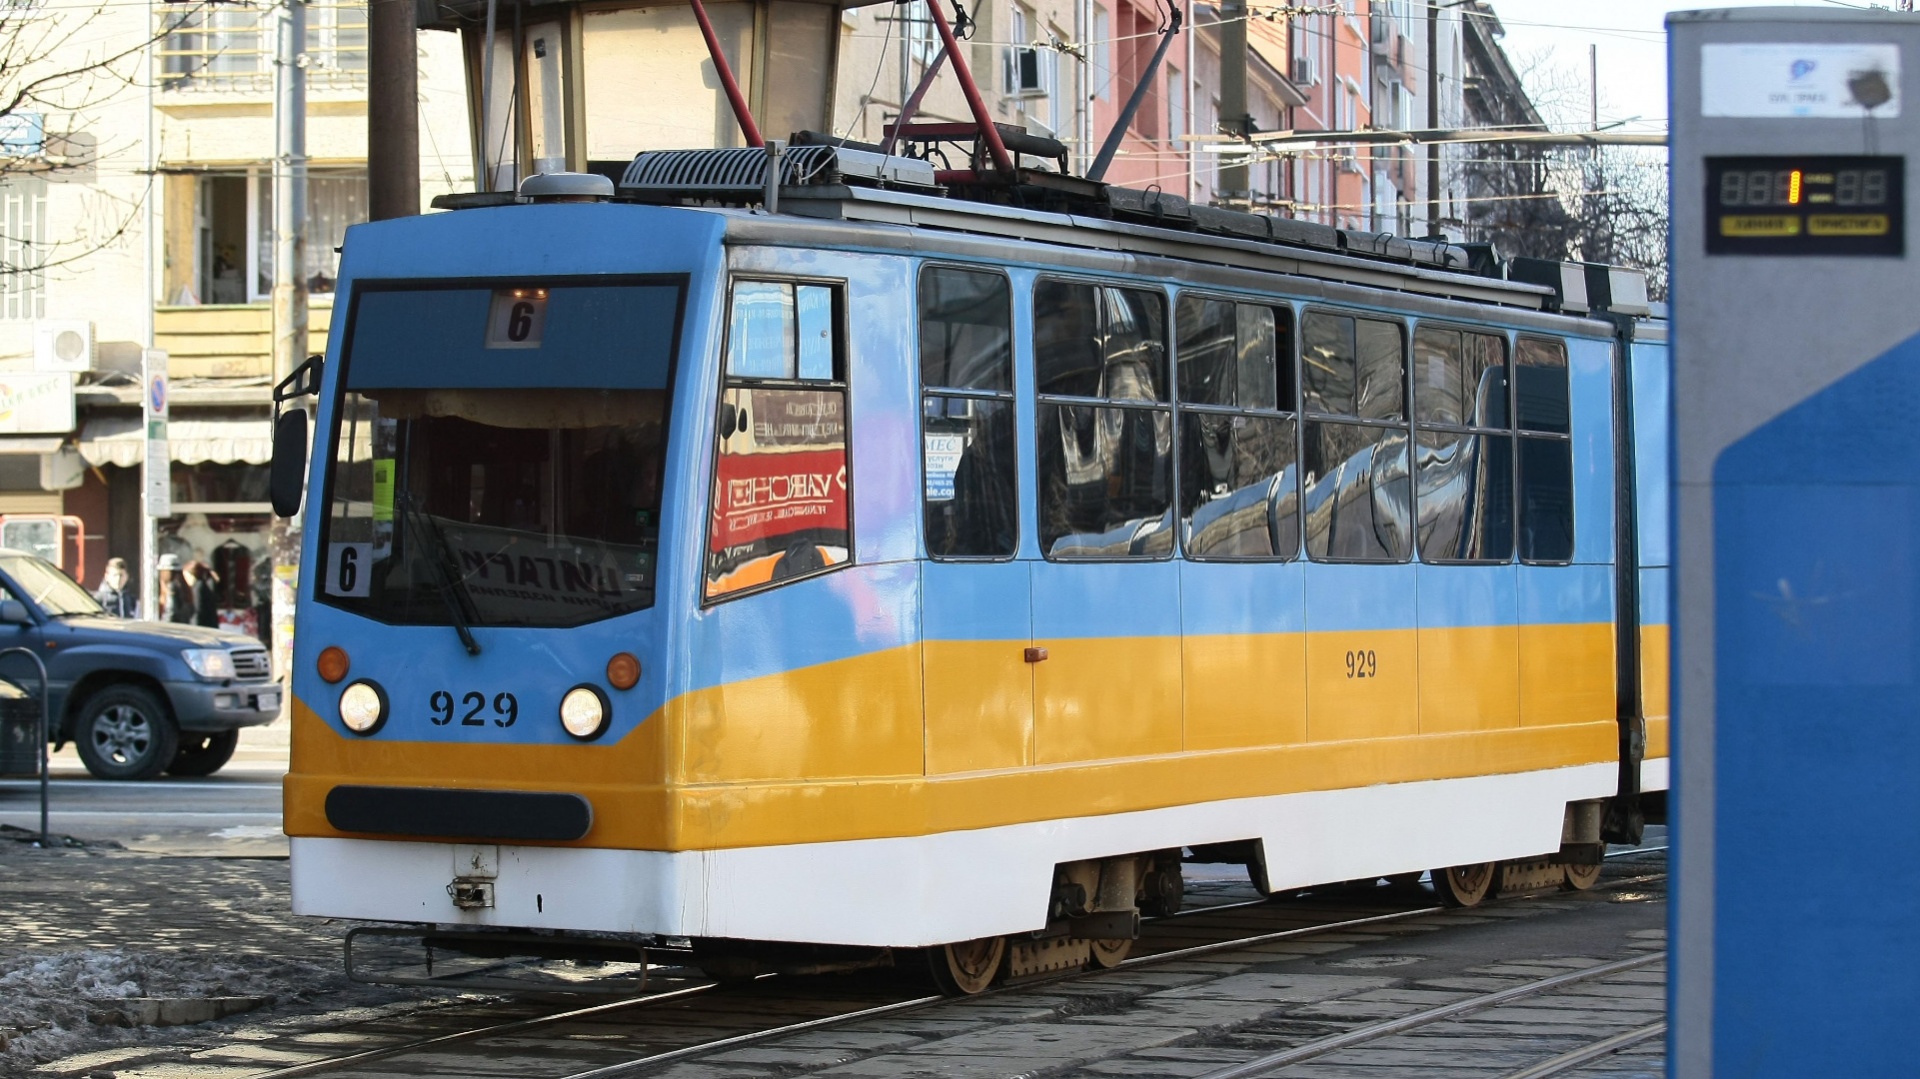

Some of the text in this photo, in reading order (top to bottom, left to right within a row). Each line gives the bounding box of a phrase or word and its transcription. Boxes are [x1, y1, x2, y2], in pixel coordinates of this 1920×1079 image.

[507, 301, 535, 342] 6
[339, 546, 358, 592] 6
[1345, 649, 1377, 679] 929
[429, 690, 520, 728] 929
